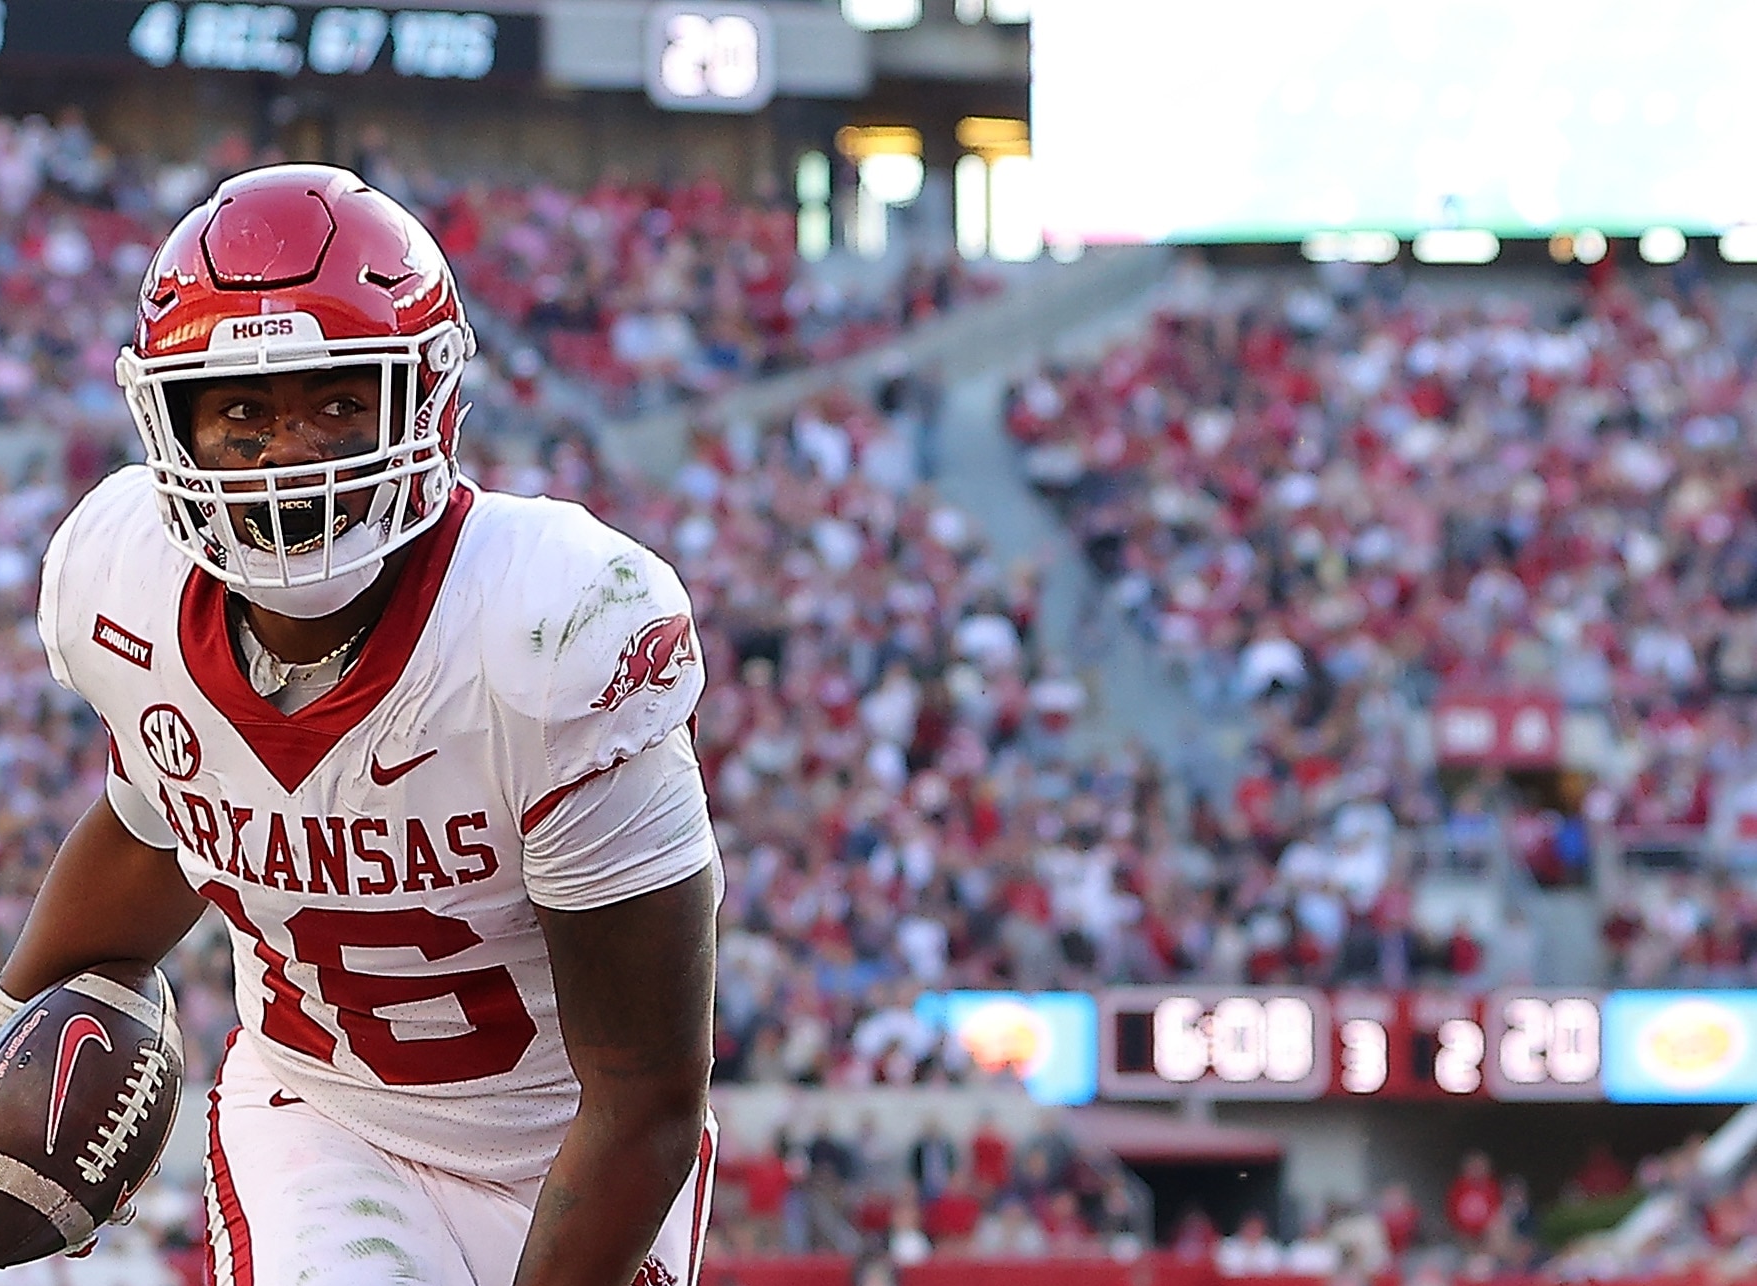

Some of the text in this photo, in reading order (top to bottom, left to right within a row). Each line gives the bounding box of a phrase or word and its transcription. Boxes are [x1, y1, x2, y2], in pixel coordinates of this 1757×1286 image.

[232, 318, 294, 340] HOGS
[100, 625, 150, 663] EQUALITY
[143, 709, 195, 778] SEC
[157, 784, 499, 894] ARKANSAS
[197, 880, 538, 1086] 16
[1340, 1018, 1389, 1094] 3
[1434, 1018, 1486, 1094] 2
